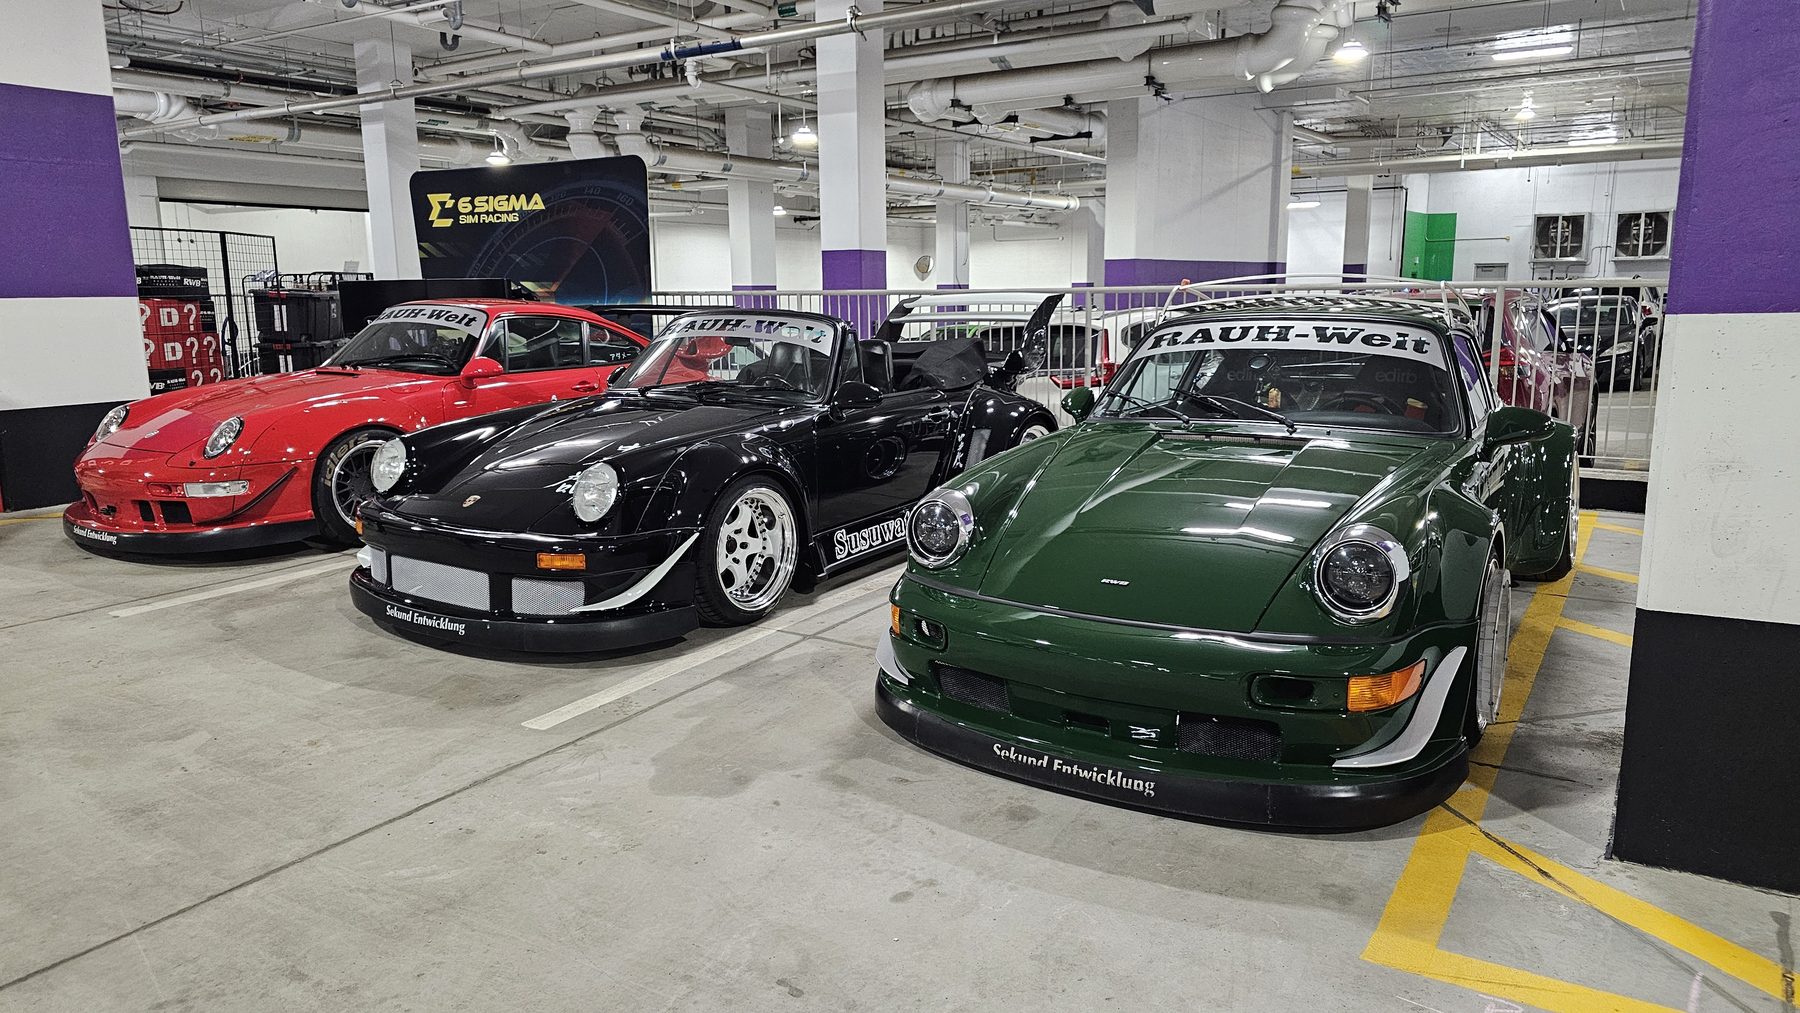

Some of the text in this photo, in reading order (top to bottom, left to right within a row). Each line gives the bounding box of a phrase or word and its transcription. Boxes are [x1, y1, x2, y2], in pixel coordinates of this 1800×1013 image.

[457, 193, 545, 213] 6 SIGMA
[459, 213, 519, 224] SIM RACING
[1147, 325, 1431, 354] RAUH-Welt
[386, 604, 466, 636] Sekund Entwicklung
[992, 743, 1156, 798] Sekund Entwicklung
